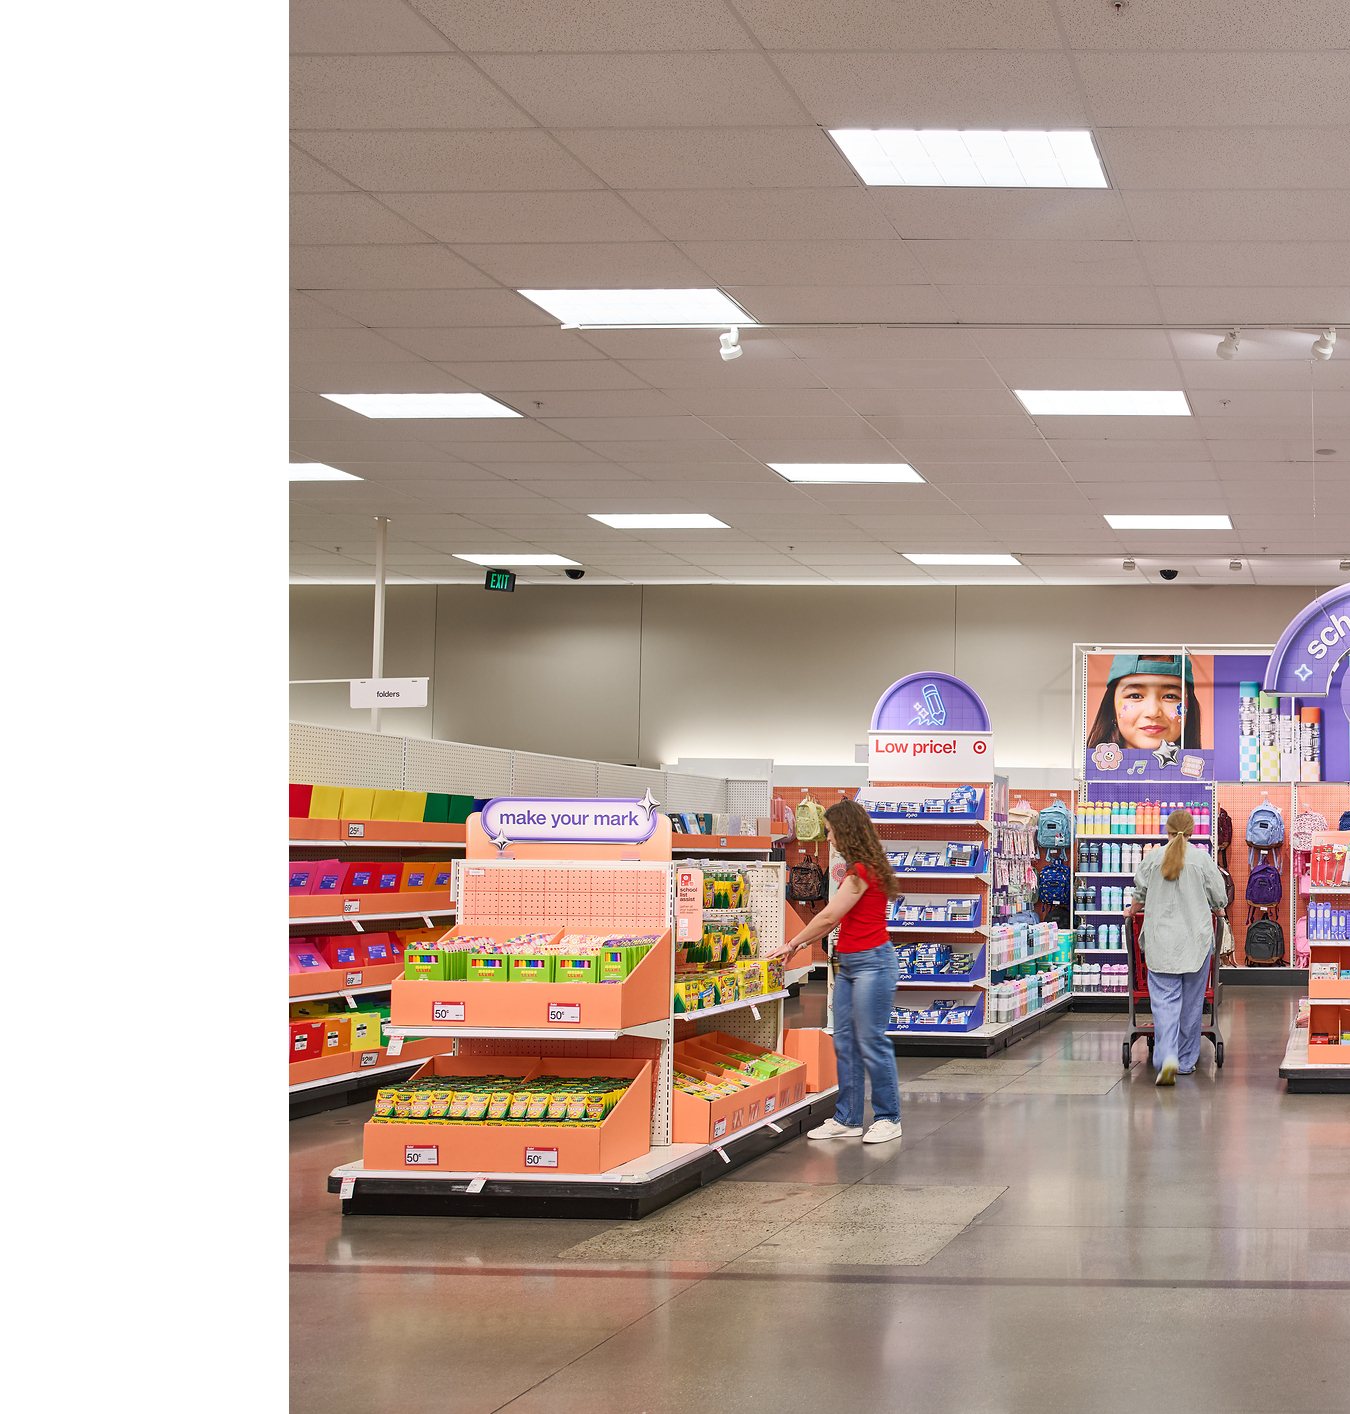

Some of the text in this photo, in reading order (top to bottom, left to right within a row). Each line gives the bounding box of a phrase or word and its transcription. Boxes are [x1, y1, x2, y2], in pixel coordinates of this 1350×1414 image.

[490, 573, 510, 590] EXIT
[376, 690, 400, 698] folders
[875, 739, 957, 757] Low price!
[500, 810, 639, 828] make your mark
[435, 1009, 449, 1019] 50¢
[550, 1010, 564, 1020] 50¢
[406, 1153, 421, 1163] 50¢
[526, 1155, 542, 1164] 50¢
